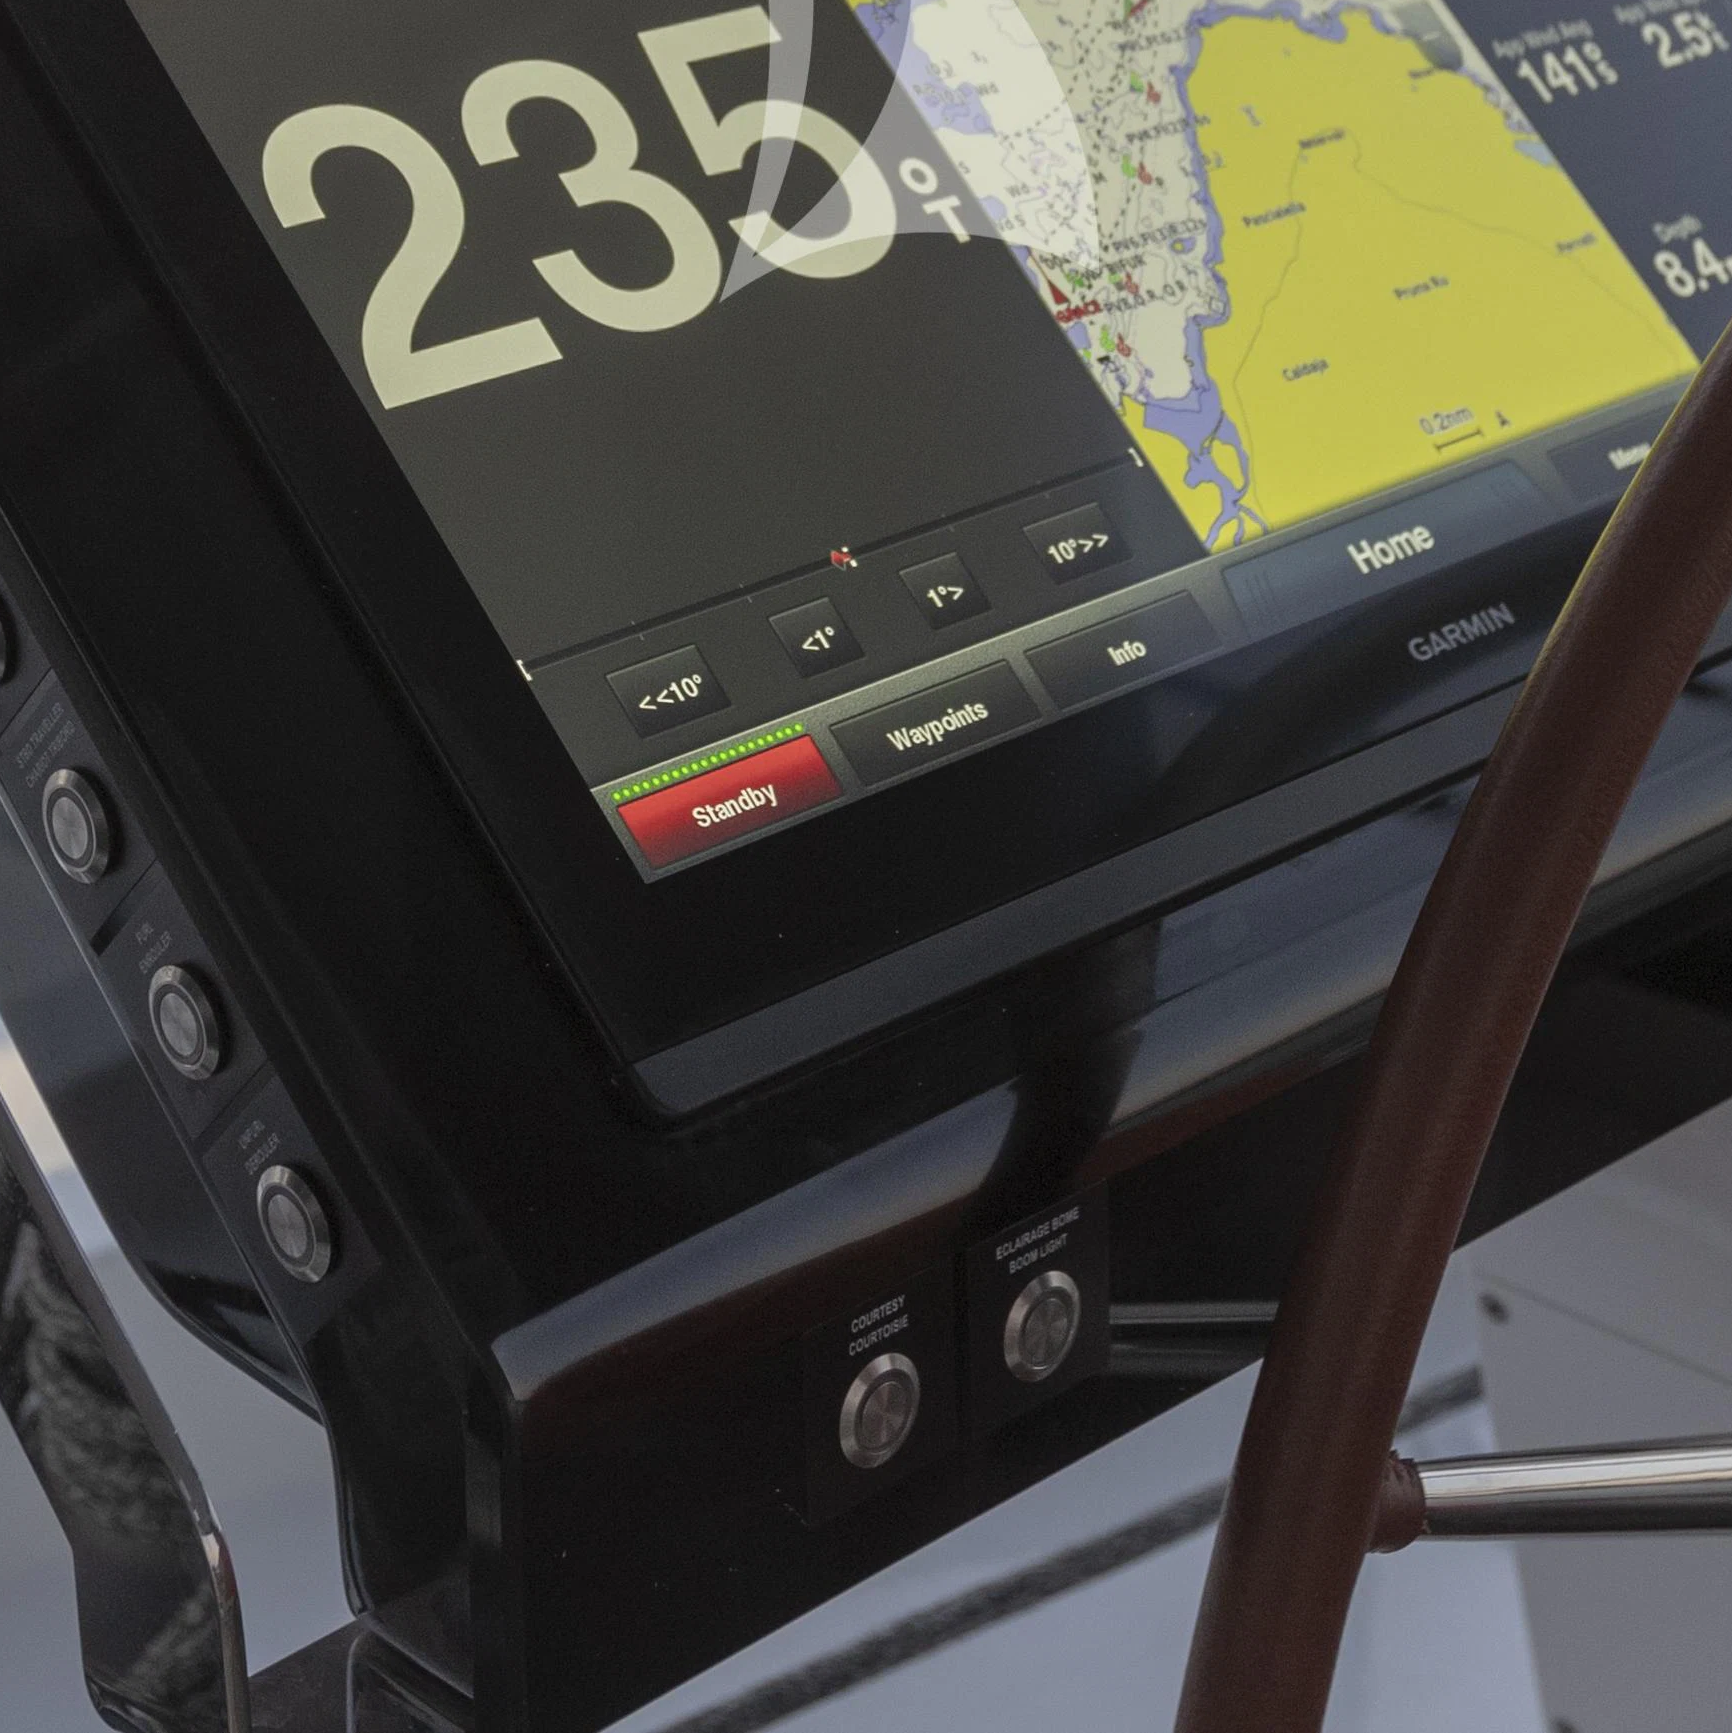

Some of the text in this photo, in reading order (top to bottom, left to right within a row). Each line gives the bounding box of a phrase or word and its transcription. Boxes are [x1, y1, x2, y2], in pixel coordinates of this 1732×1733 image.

[1347, 524, 1435, 575] Home
[1106, 637, 1146, 666] Info
[1408, 601, 1516, 662] GARMIN
[887, 700, 989, 752] Waypoints
[692, 782, 778, 828] Standby
[996, 1221, 1051, 1261] ECLAIRAGE
[1009, 1233, 1068, 1275] BOOM LIGHT
[848, 1314, 910, 1357] COURTOISIE
[851, 1294, 906, 1334] COURTESY
